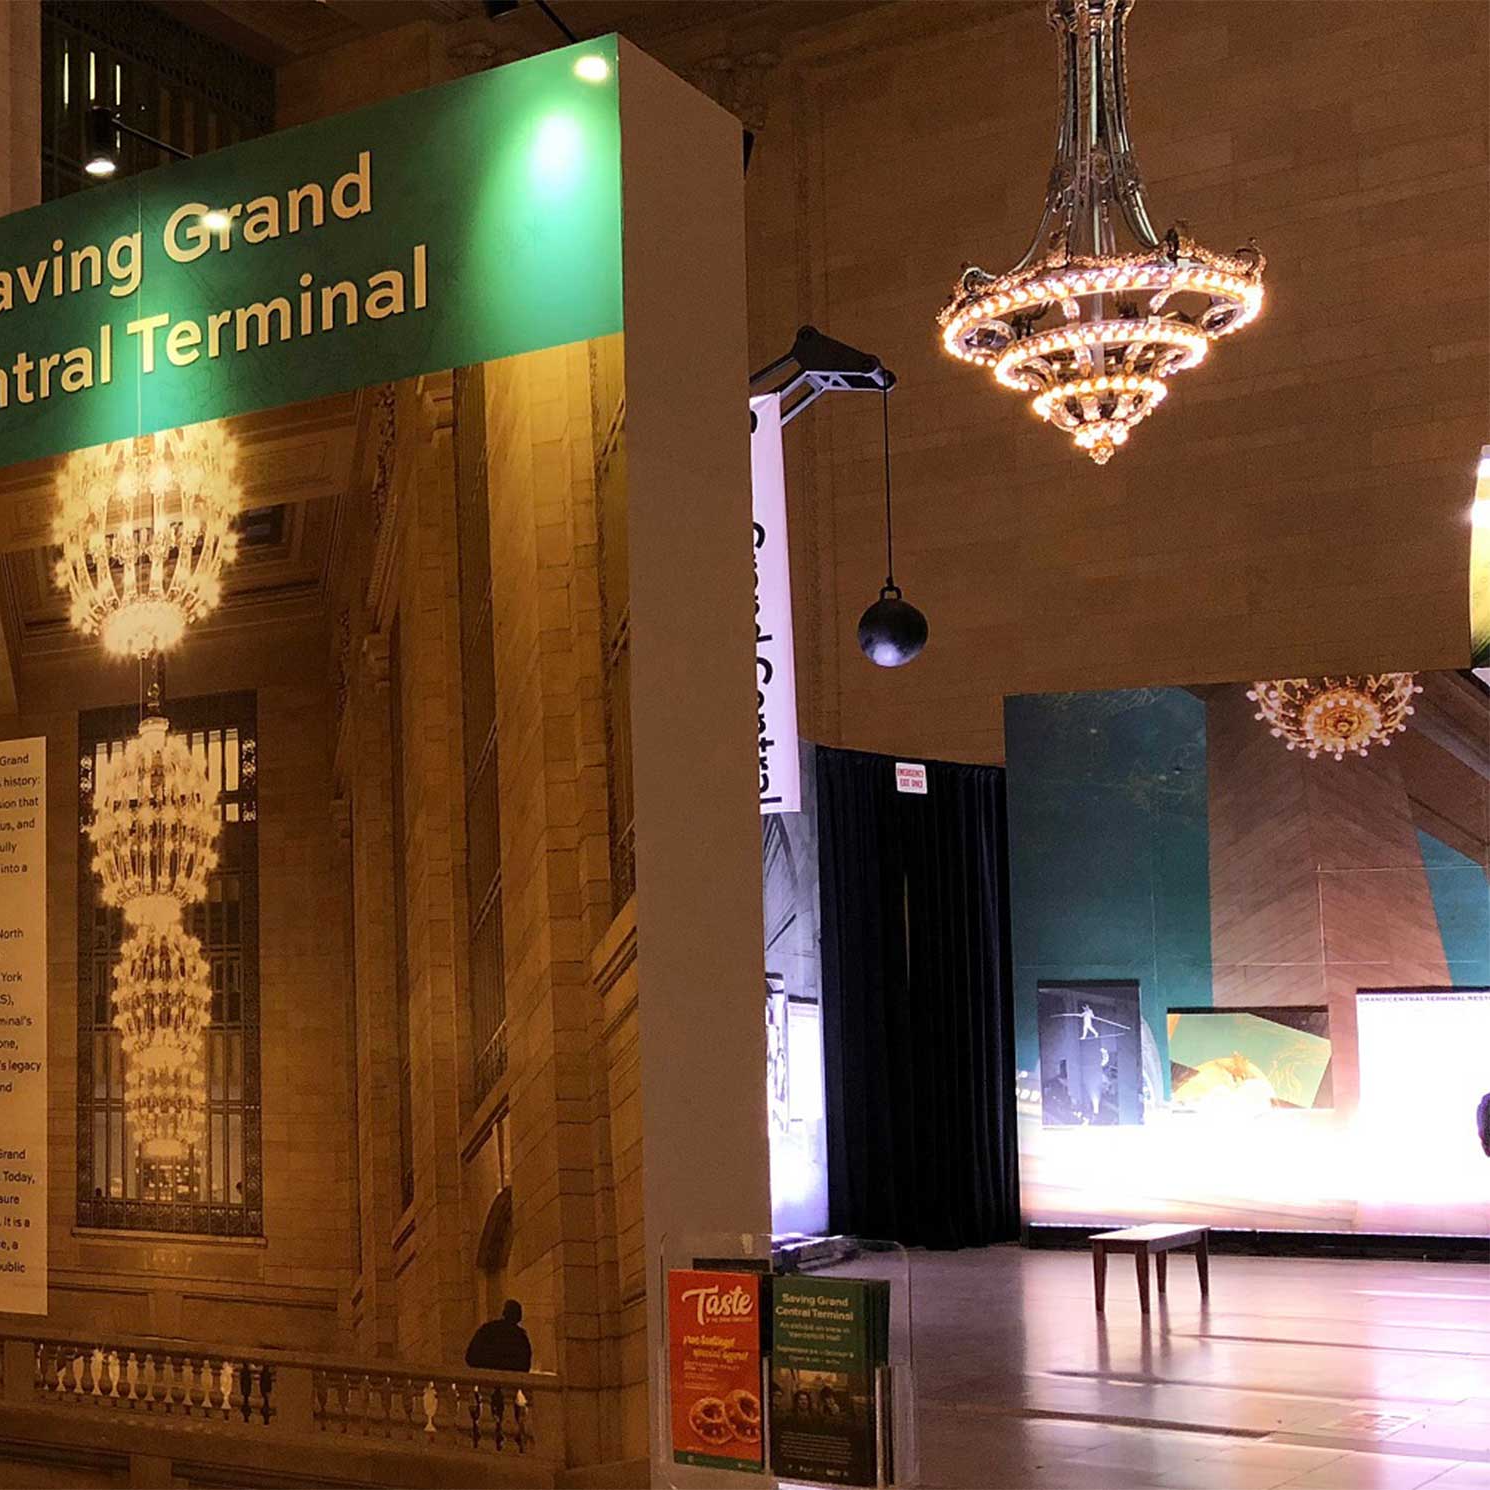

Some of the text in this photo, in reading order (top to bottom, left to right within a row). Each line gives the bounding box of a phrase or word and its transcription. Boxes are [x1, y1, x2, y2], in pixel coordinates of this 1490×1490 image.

[162, 150, 373, 264] Grand
[126, 243, 428, 375] Terminal
[3, 776, 40, 791] history:
[18, 797, 38, 807] that
[16, 818, 35, 829] and
[0, 863, 20, 874] into
[3, 1216, 11, 1225] It
[12, 1217, 22, 1226] is
[681, 1285, 754, 1326] Taste
[782, 1293, 849, 1307] Saving Grand
[775, 1306, 854, 1321] Central Terminal
